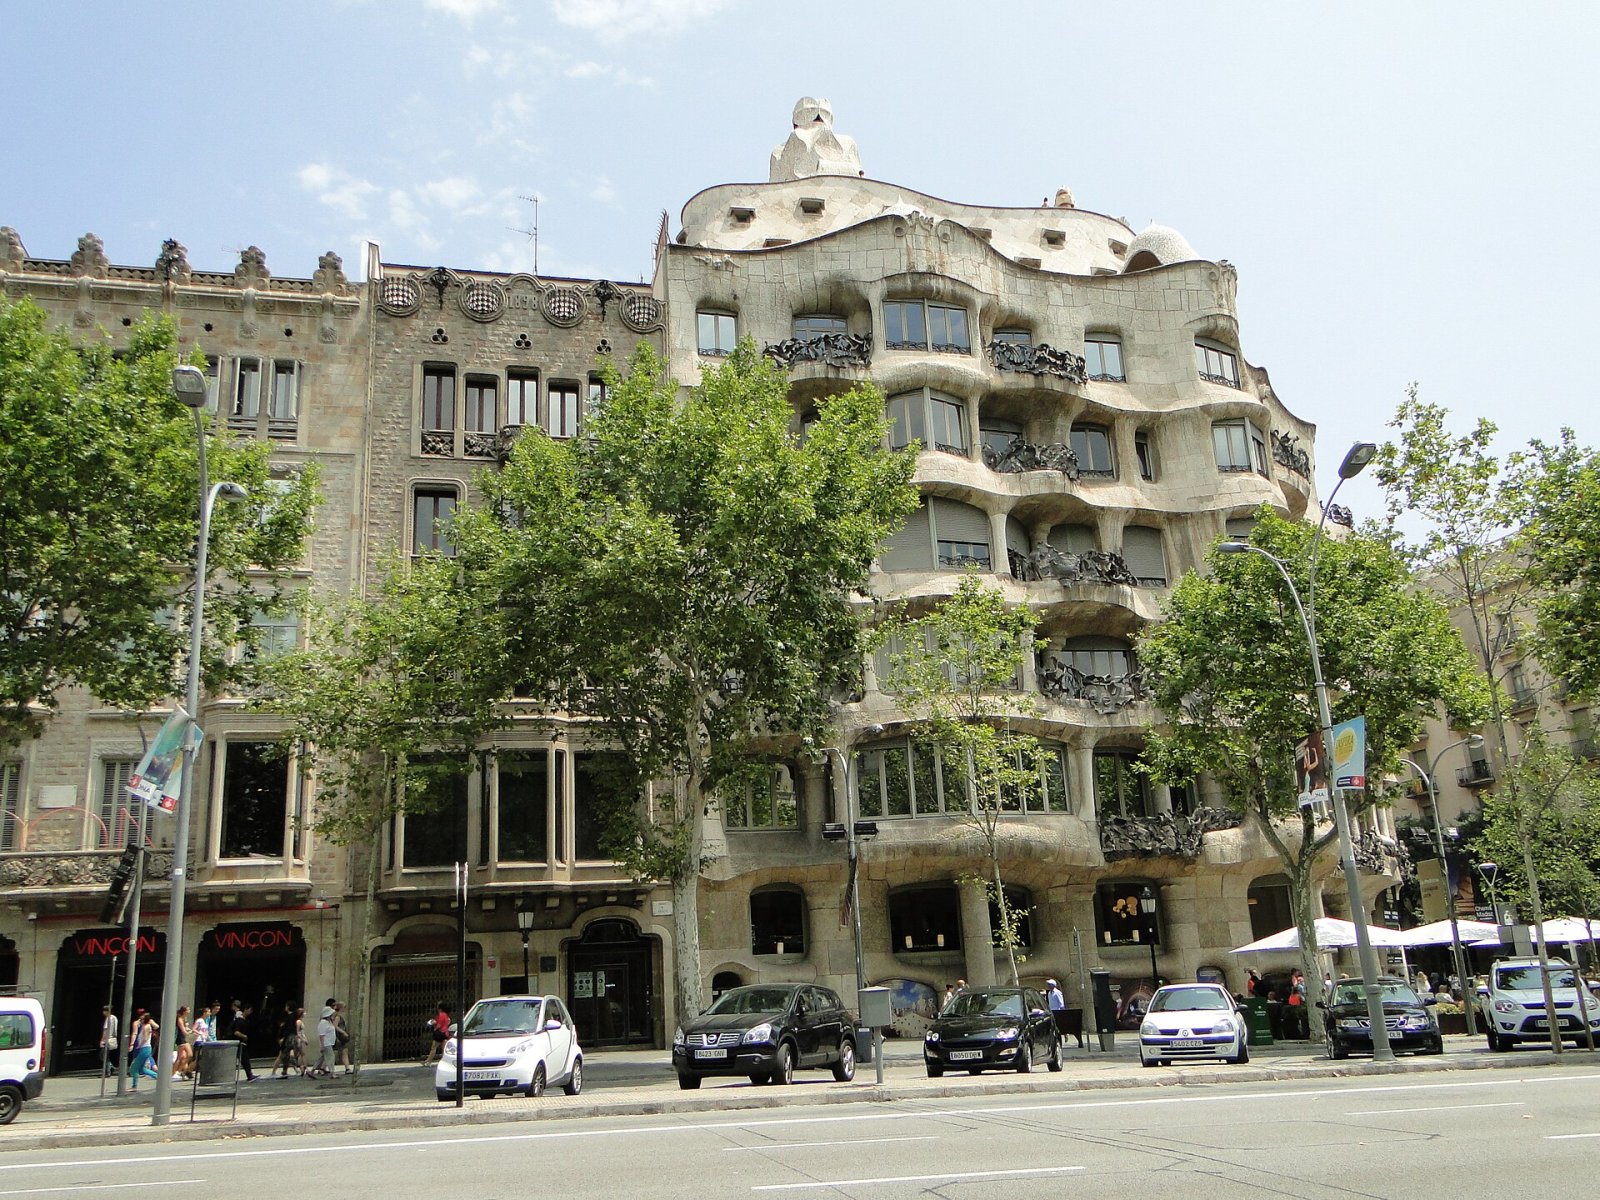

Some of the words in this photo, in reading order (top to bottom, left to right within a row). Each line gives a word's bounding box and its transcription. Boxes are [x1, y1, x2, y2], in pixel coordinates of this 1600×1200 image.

[508, 293, 538, 310] 1898
[75, 936, 156, 956] VINÇON
[214, 928, 293, 950] VINÇON
[468, 1072, 485, 1080] 7082
